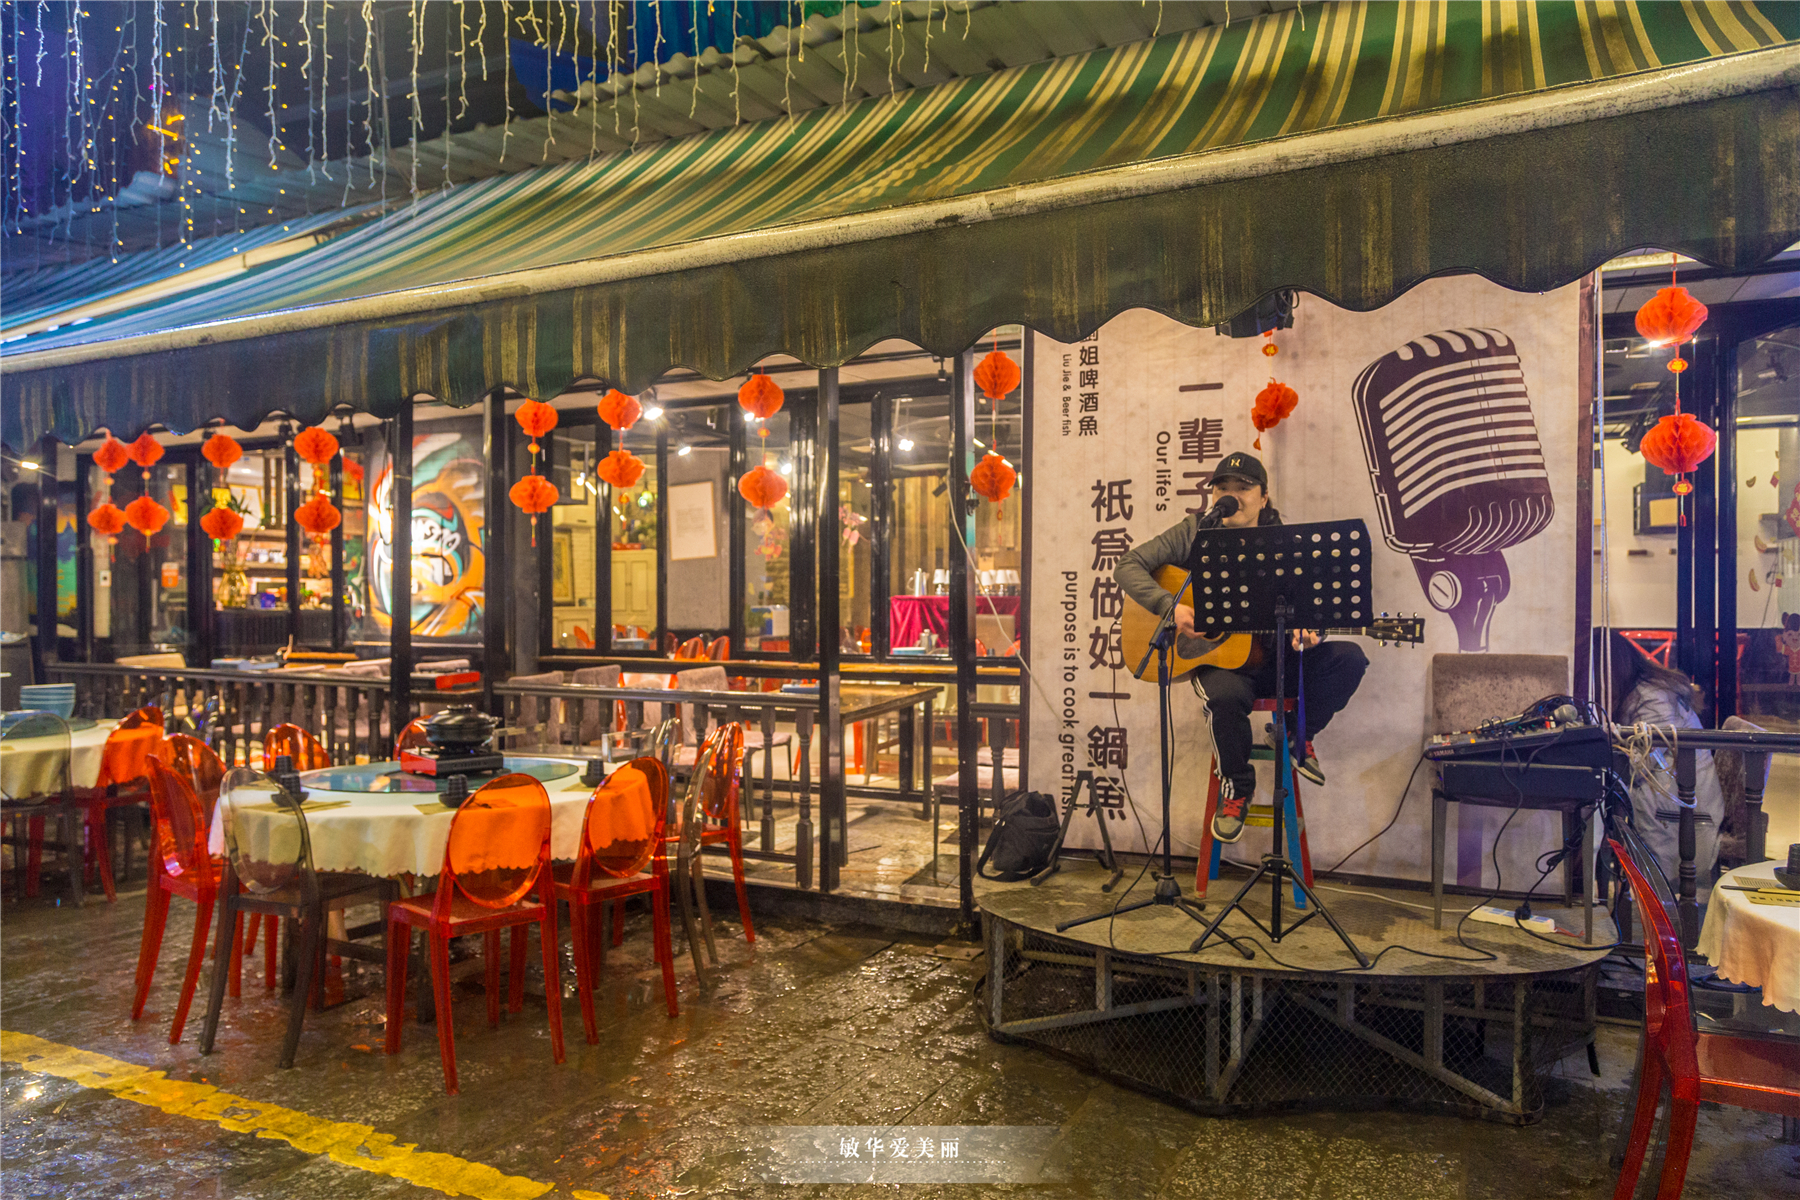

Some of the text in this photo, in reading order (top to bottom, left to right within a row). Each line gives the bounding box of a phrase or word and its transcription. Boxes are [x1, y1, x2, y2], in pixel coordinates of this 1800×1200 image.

[1062, 353, 1072, 436] Liu Jie & Beer fish
[1079, 329, 1099, 436] 姐啤酒魚
[1155, 431, 1171, 511] Our life's
[1176, 382, 1223, 514] 一輩子
[1060, 571, 1078, 642] purpose
[1063, 648, 1080, 660] is
[1063, 665, 1079, 682] to
[1062, 687, 1080, 728] cook
[1058, 733, 1077, 782] great
